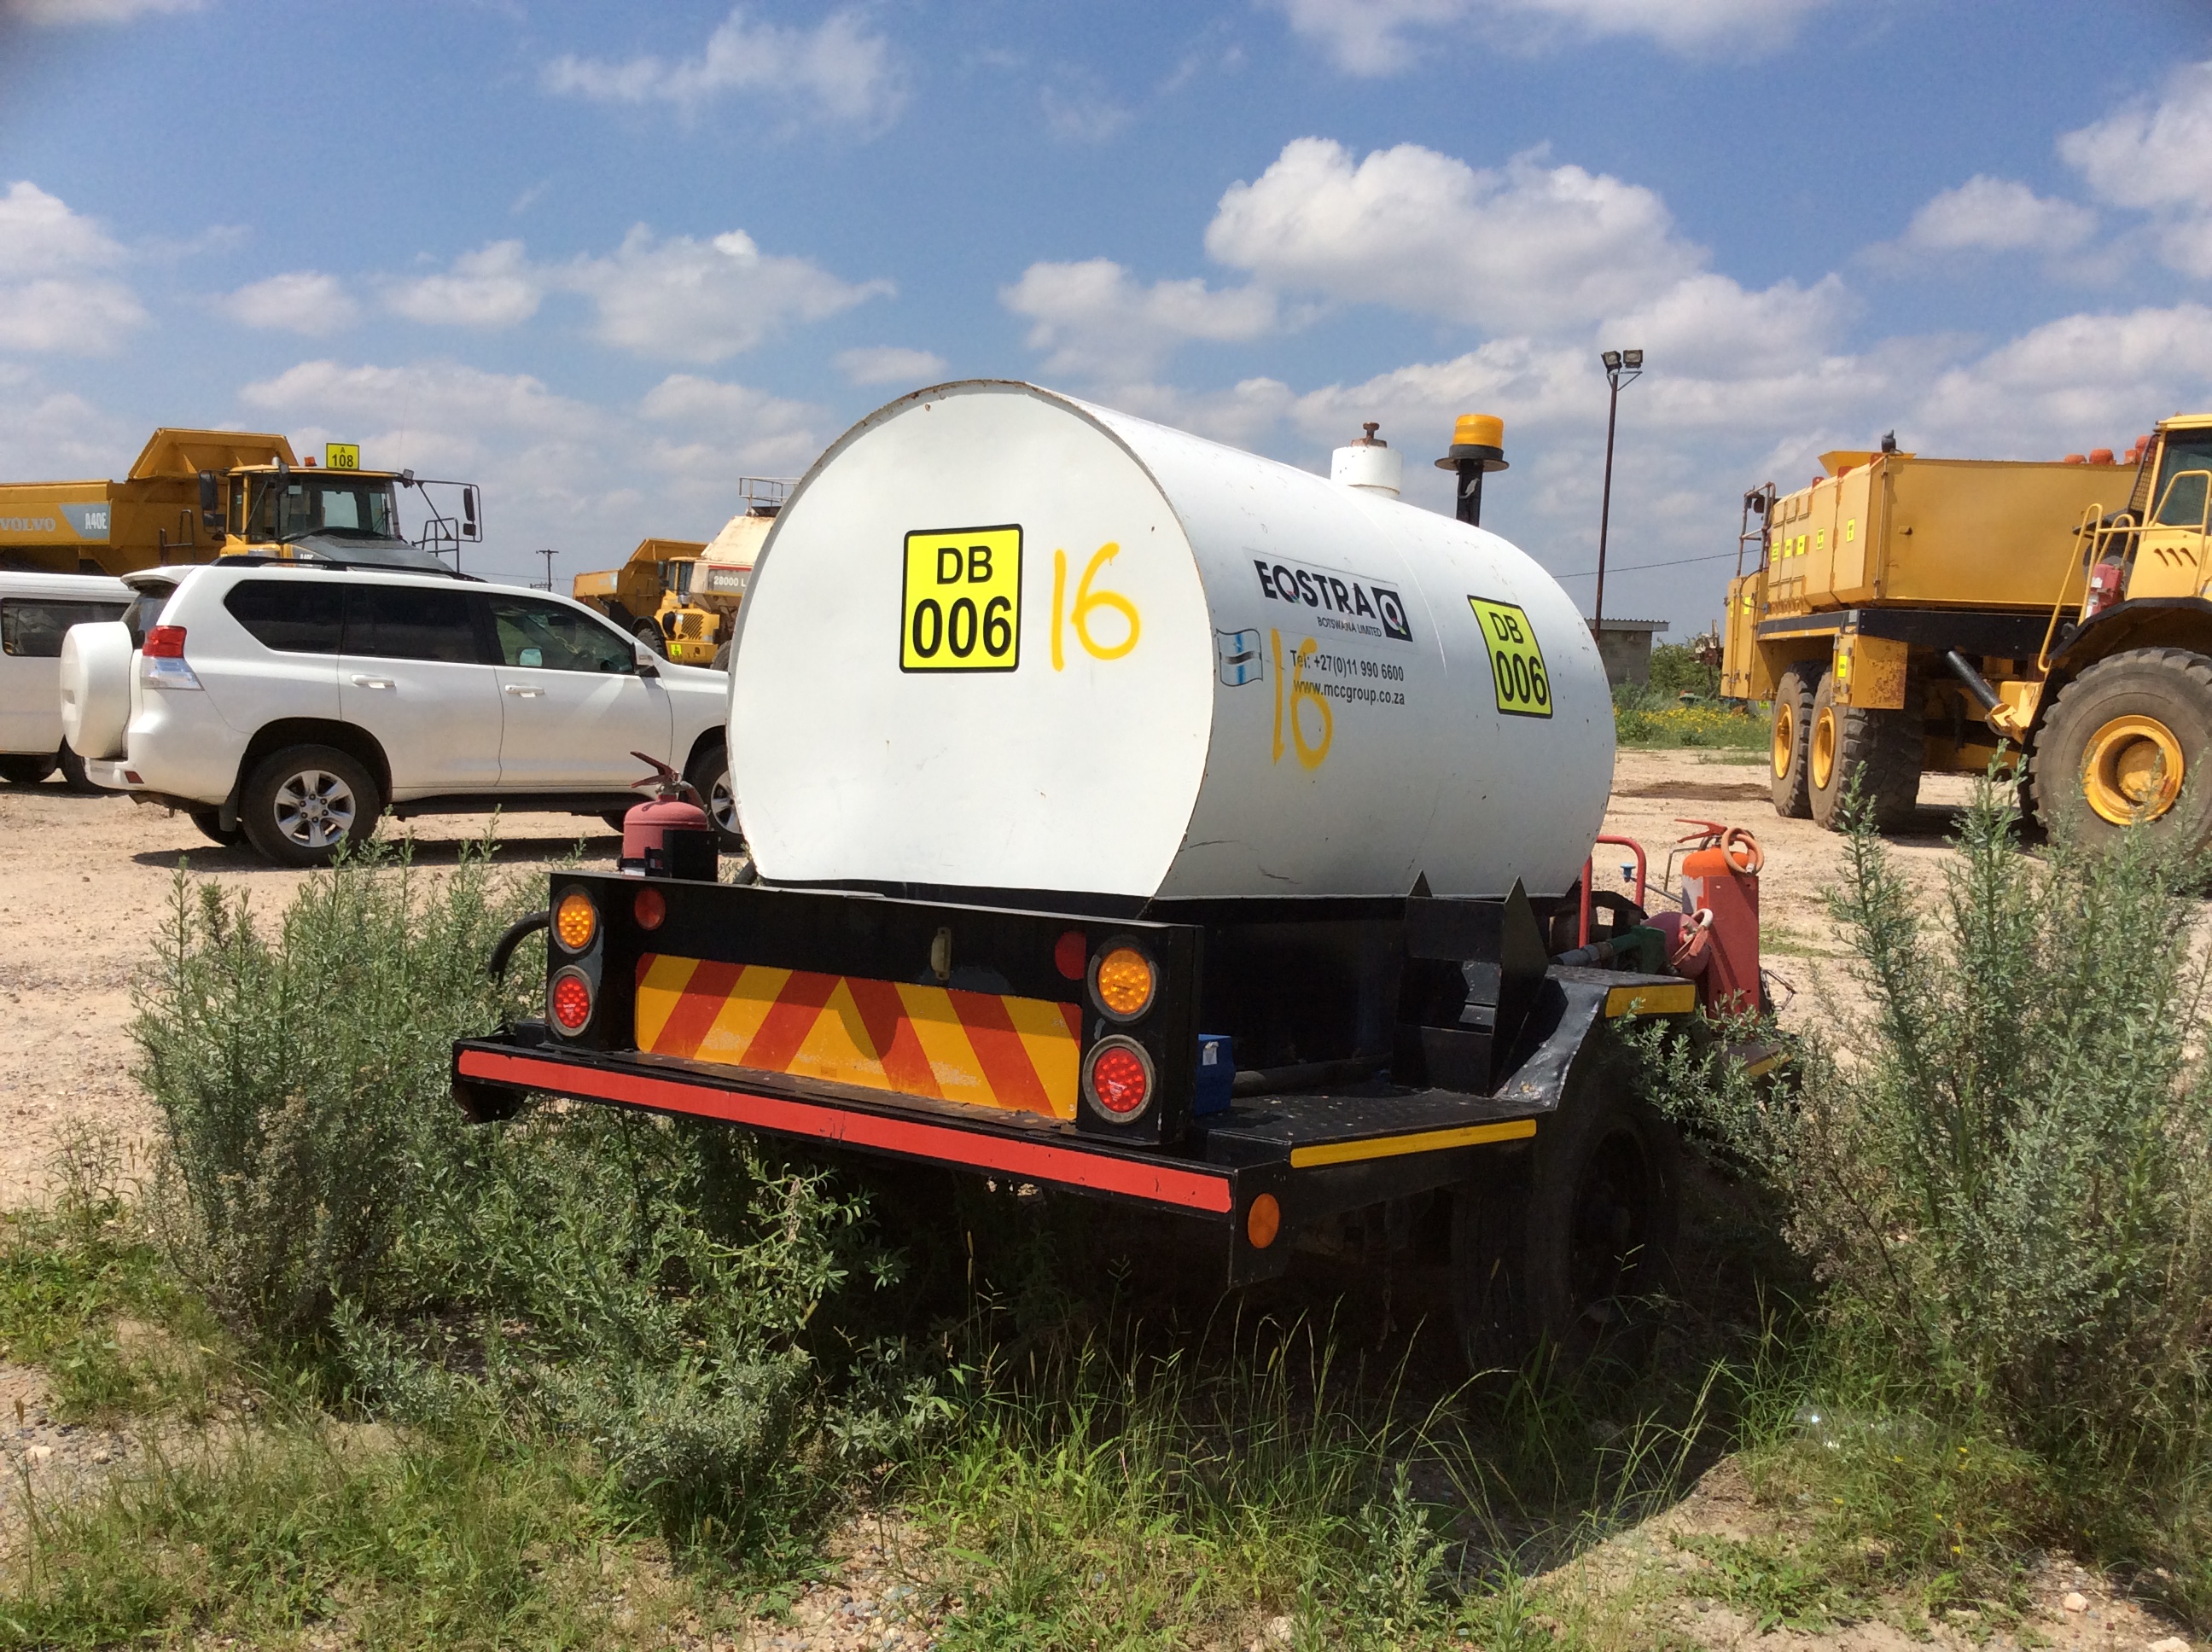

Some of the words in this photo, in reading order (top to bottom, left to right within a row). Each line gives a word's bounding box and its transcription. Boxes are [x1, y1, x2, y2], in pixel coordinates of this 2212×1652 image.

[332, 454, 353, 467] 108
[0, 517, 55, 532] VOLVO
[84, 512, 107, 530] A40E
[713, 575, 739, 586] 28000
[936, 545, 993, 585] DB
[1051, 541, 1141, 672] 16
[912, 596, 1012, 658] 006
[1317, 616, 1357, 632] BOTSWANA
[1357, 624, 1382, 637] LIMITED
[1488, 611, 1524, 644] DB
[1289, 649, 1311, 669] Tel:
[1313, 654, 1358, 678] +27(0)11
[1361, 660, 1378, 679] 990
[1381, 663, 1404, 682] 6600
[1496, 650, 1547, 706] 006
[1271, 629, 1334, 771] 16
[1293, 679, 1406, 706] www.mccgroup.co.za
